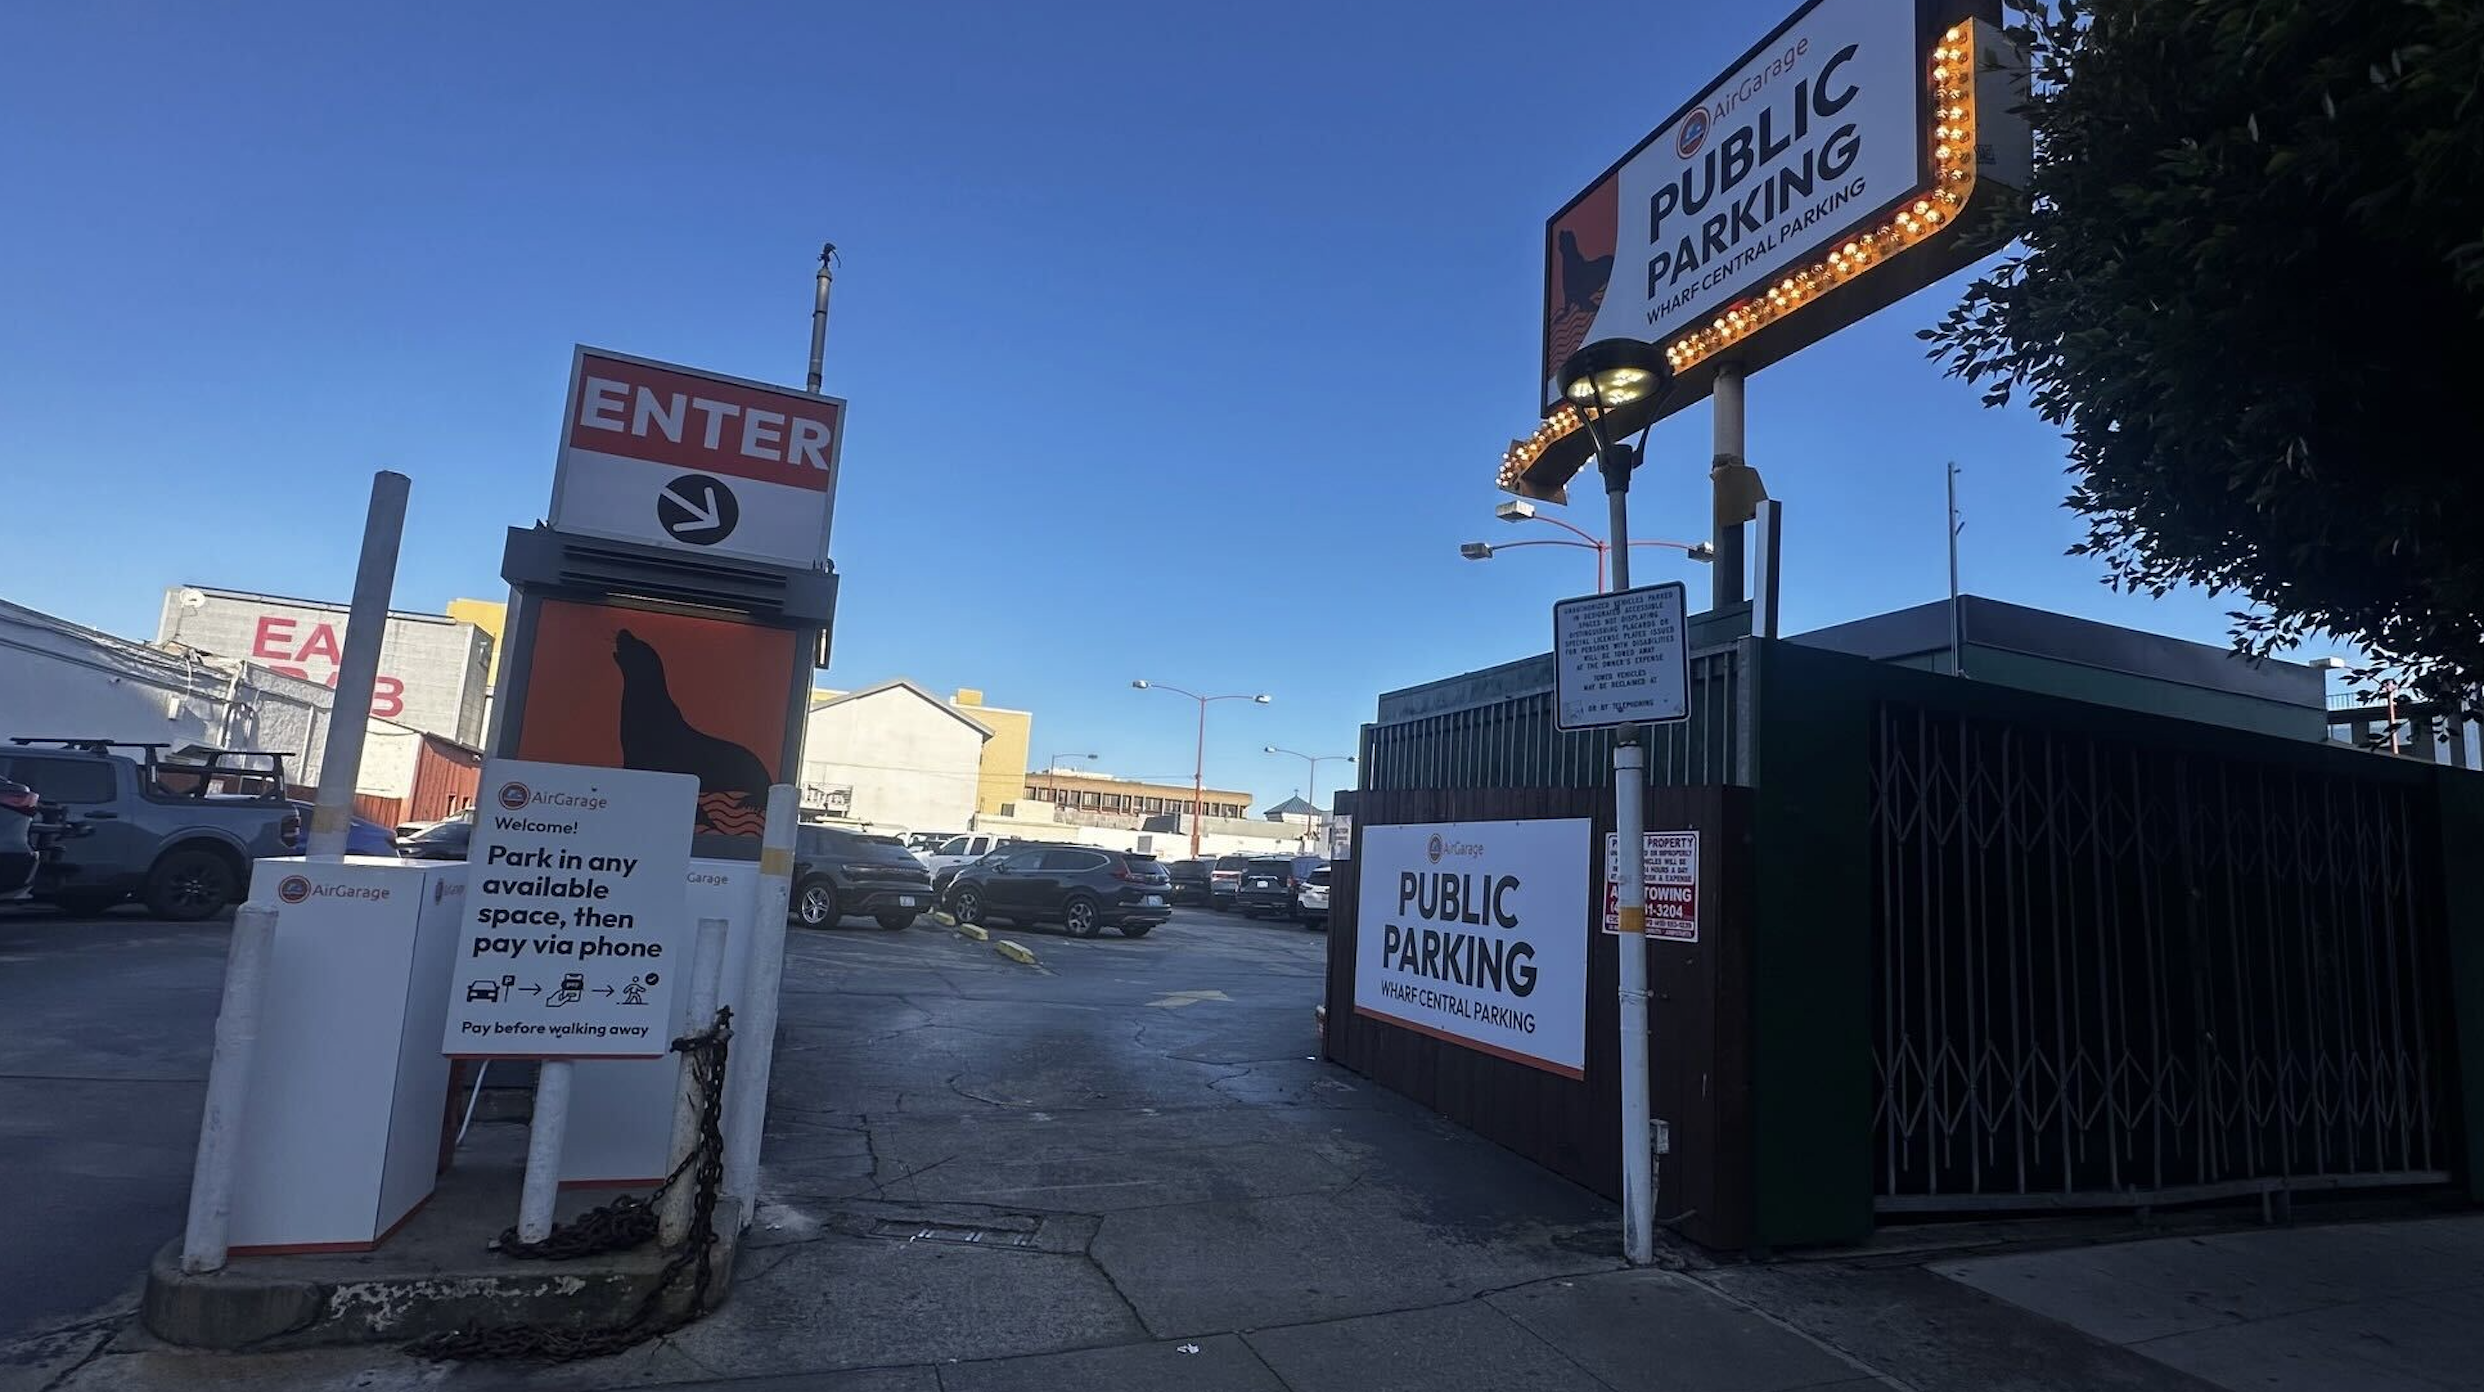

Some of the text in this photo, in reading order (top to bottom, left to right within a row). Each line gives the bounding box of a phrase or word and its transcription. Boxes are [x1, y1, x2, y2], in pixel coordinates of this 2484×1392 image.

[1713, 37, 1808, 126] AirGarage
[1650, 44, 1860, 245] PUBLIC
[1648, 123, 1861, 300] PARKING
[1647, 176, 1866, 326] WHARF CENTRAL PARKING
[579, 375, 832, 471] ENTER
[1614, 597, 1643, 607] VEHICLES
[1648, 591, 1674, 601] PARKED
[1579, 611, 1659, 629] SPACES NOT DISPLAYING
[1584, 609, 1620, 620] DESIGNATED
[1625, 602, 1663, 613] ACCESSIBLE
[1565, 626, 1674, 647] SPECIAL LICENSE PLATES ISSUED
[1569, 618, 1669, 638] DISTINGUISHING PLACARDS OR
[1565, 635, 1674, 655] FOR PERSONS WITH DISABILITIES
[1584, 654, 1597, 662] WILL
[1614, 649, 1634, 657] TOWED
[1639, 646, 1655, 654] AWAY
[1587, 662, 1598, 670] THE
[1602, 658, 1631, 668] OWNER'S
[1635, 654, 1664, 664] EXPENSE
[1594, 669, 1647, 681] TOWED VEHICLES
[1611, 678, 1645, 688] RECLAIMED
[1588, 704, 1597, 712] OR
[1613, 699, 1654, 711] TELEPHONING
[531, 791, 607, 810] AirGarage
[495, 816, 578, 834] Welcome!
[1443, 842, 1484, 858] AirGarage
[1648, 837, 1694, 848] PROPERTY
[488, 845, 639, 878] Park in any
[312, 884, 390, 901] AirGarage
[482, 876, 609, 899] available
[1644, 886, 1692, 902] TOWING
[1398, 870, 1521, 929] PUBLIC
[477, 907, 634, 929] space, then
[472, 934, 663, 961] pay via phone
[1382, 924, 1538, 997] PARKING
[1381, 980, 1536, 1034] WHARF CENTRAL PARKING
[461, 1021, 649, 1038] Pay before walking away
